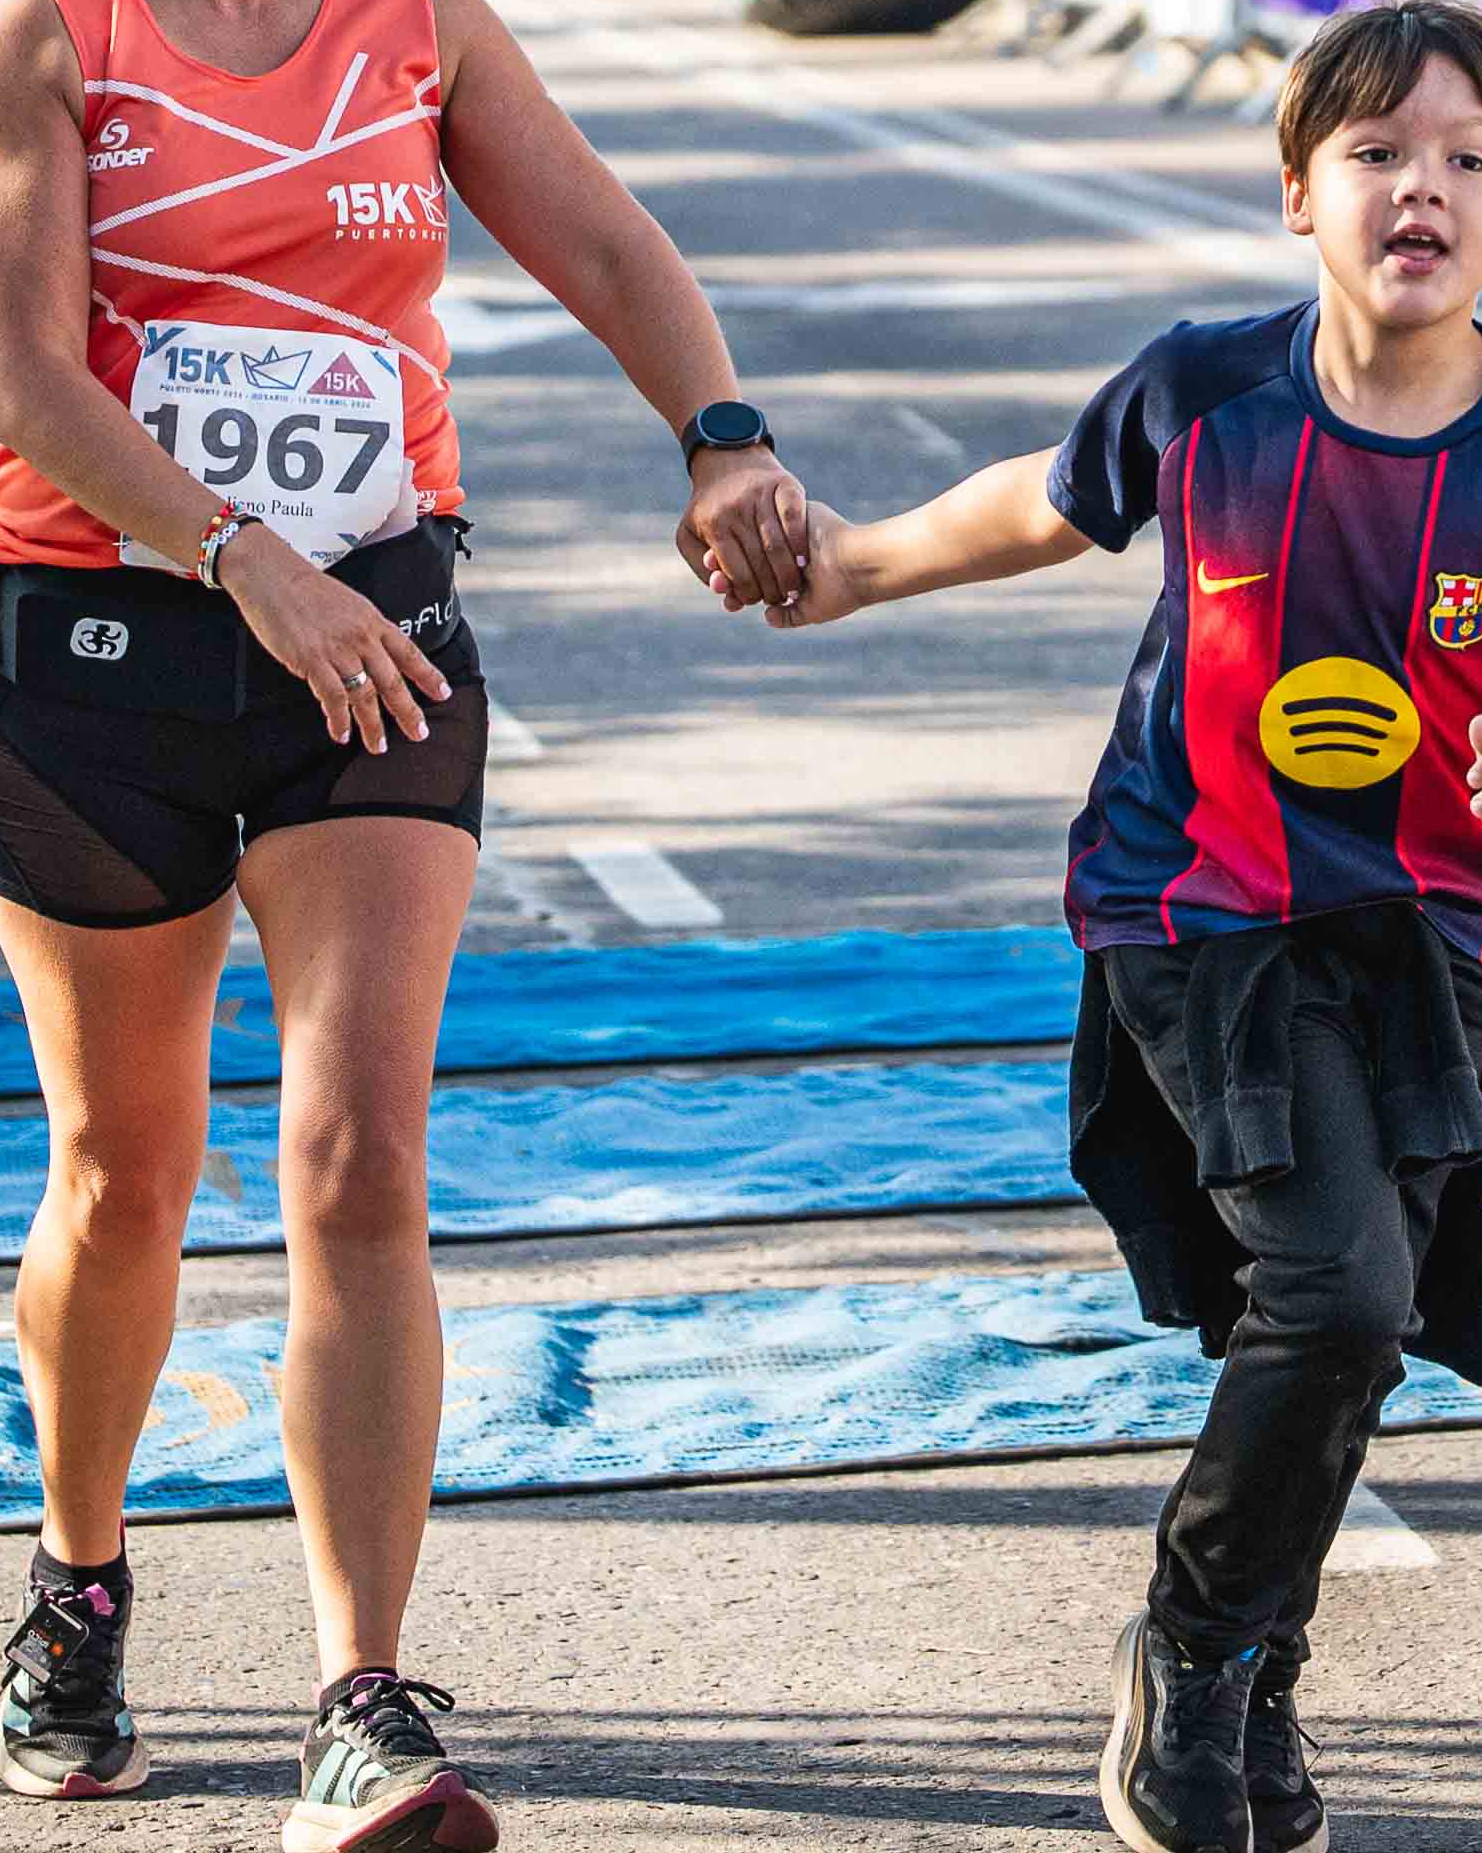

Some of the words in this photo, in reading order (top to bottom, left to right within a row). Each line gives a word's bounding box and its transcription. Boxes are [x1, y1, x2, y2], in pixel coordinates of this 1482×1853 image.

[326, 181, 416, 226] 15K
[164, 346, 235, 386] 15K
[322, 369, 361, 393] 15K
[142, 402, 391, 495] 1967
[270, 499, 314, 518] Paula
